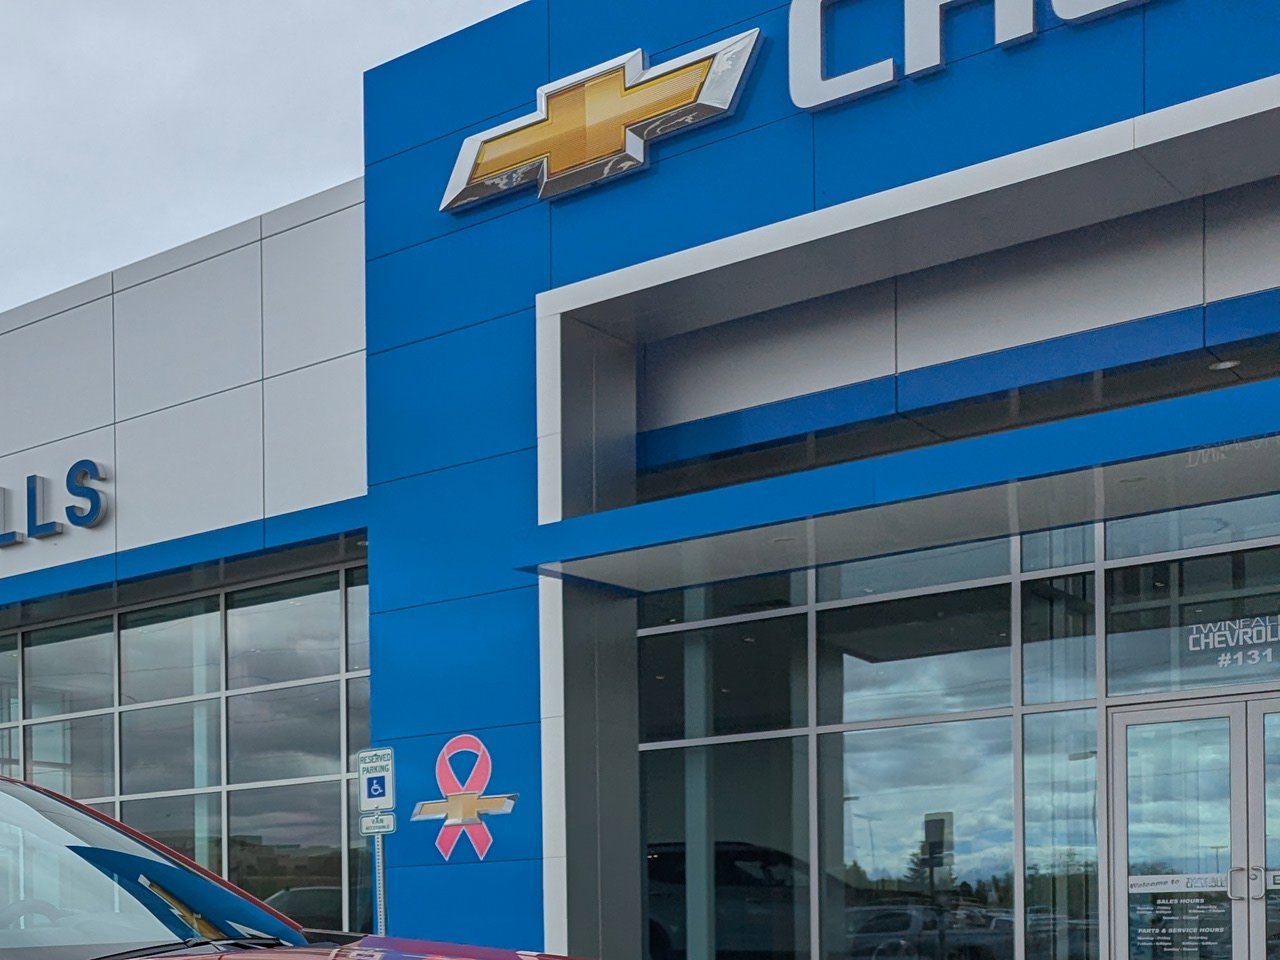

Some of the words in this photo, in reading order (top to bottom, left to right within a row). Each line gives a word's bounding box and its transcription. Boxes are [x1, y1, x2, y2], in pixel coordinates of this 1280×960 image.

[1188, 615, 1280, 634] TWINFAL
[1188, 625, 1280, 651] CHEVROL
[1217, 648, 1273, 668] #131
[360, 753, 391, 764] RESERVED
[362, 765, 389, 775] PARKING
